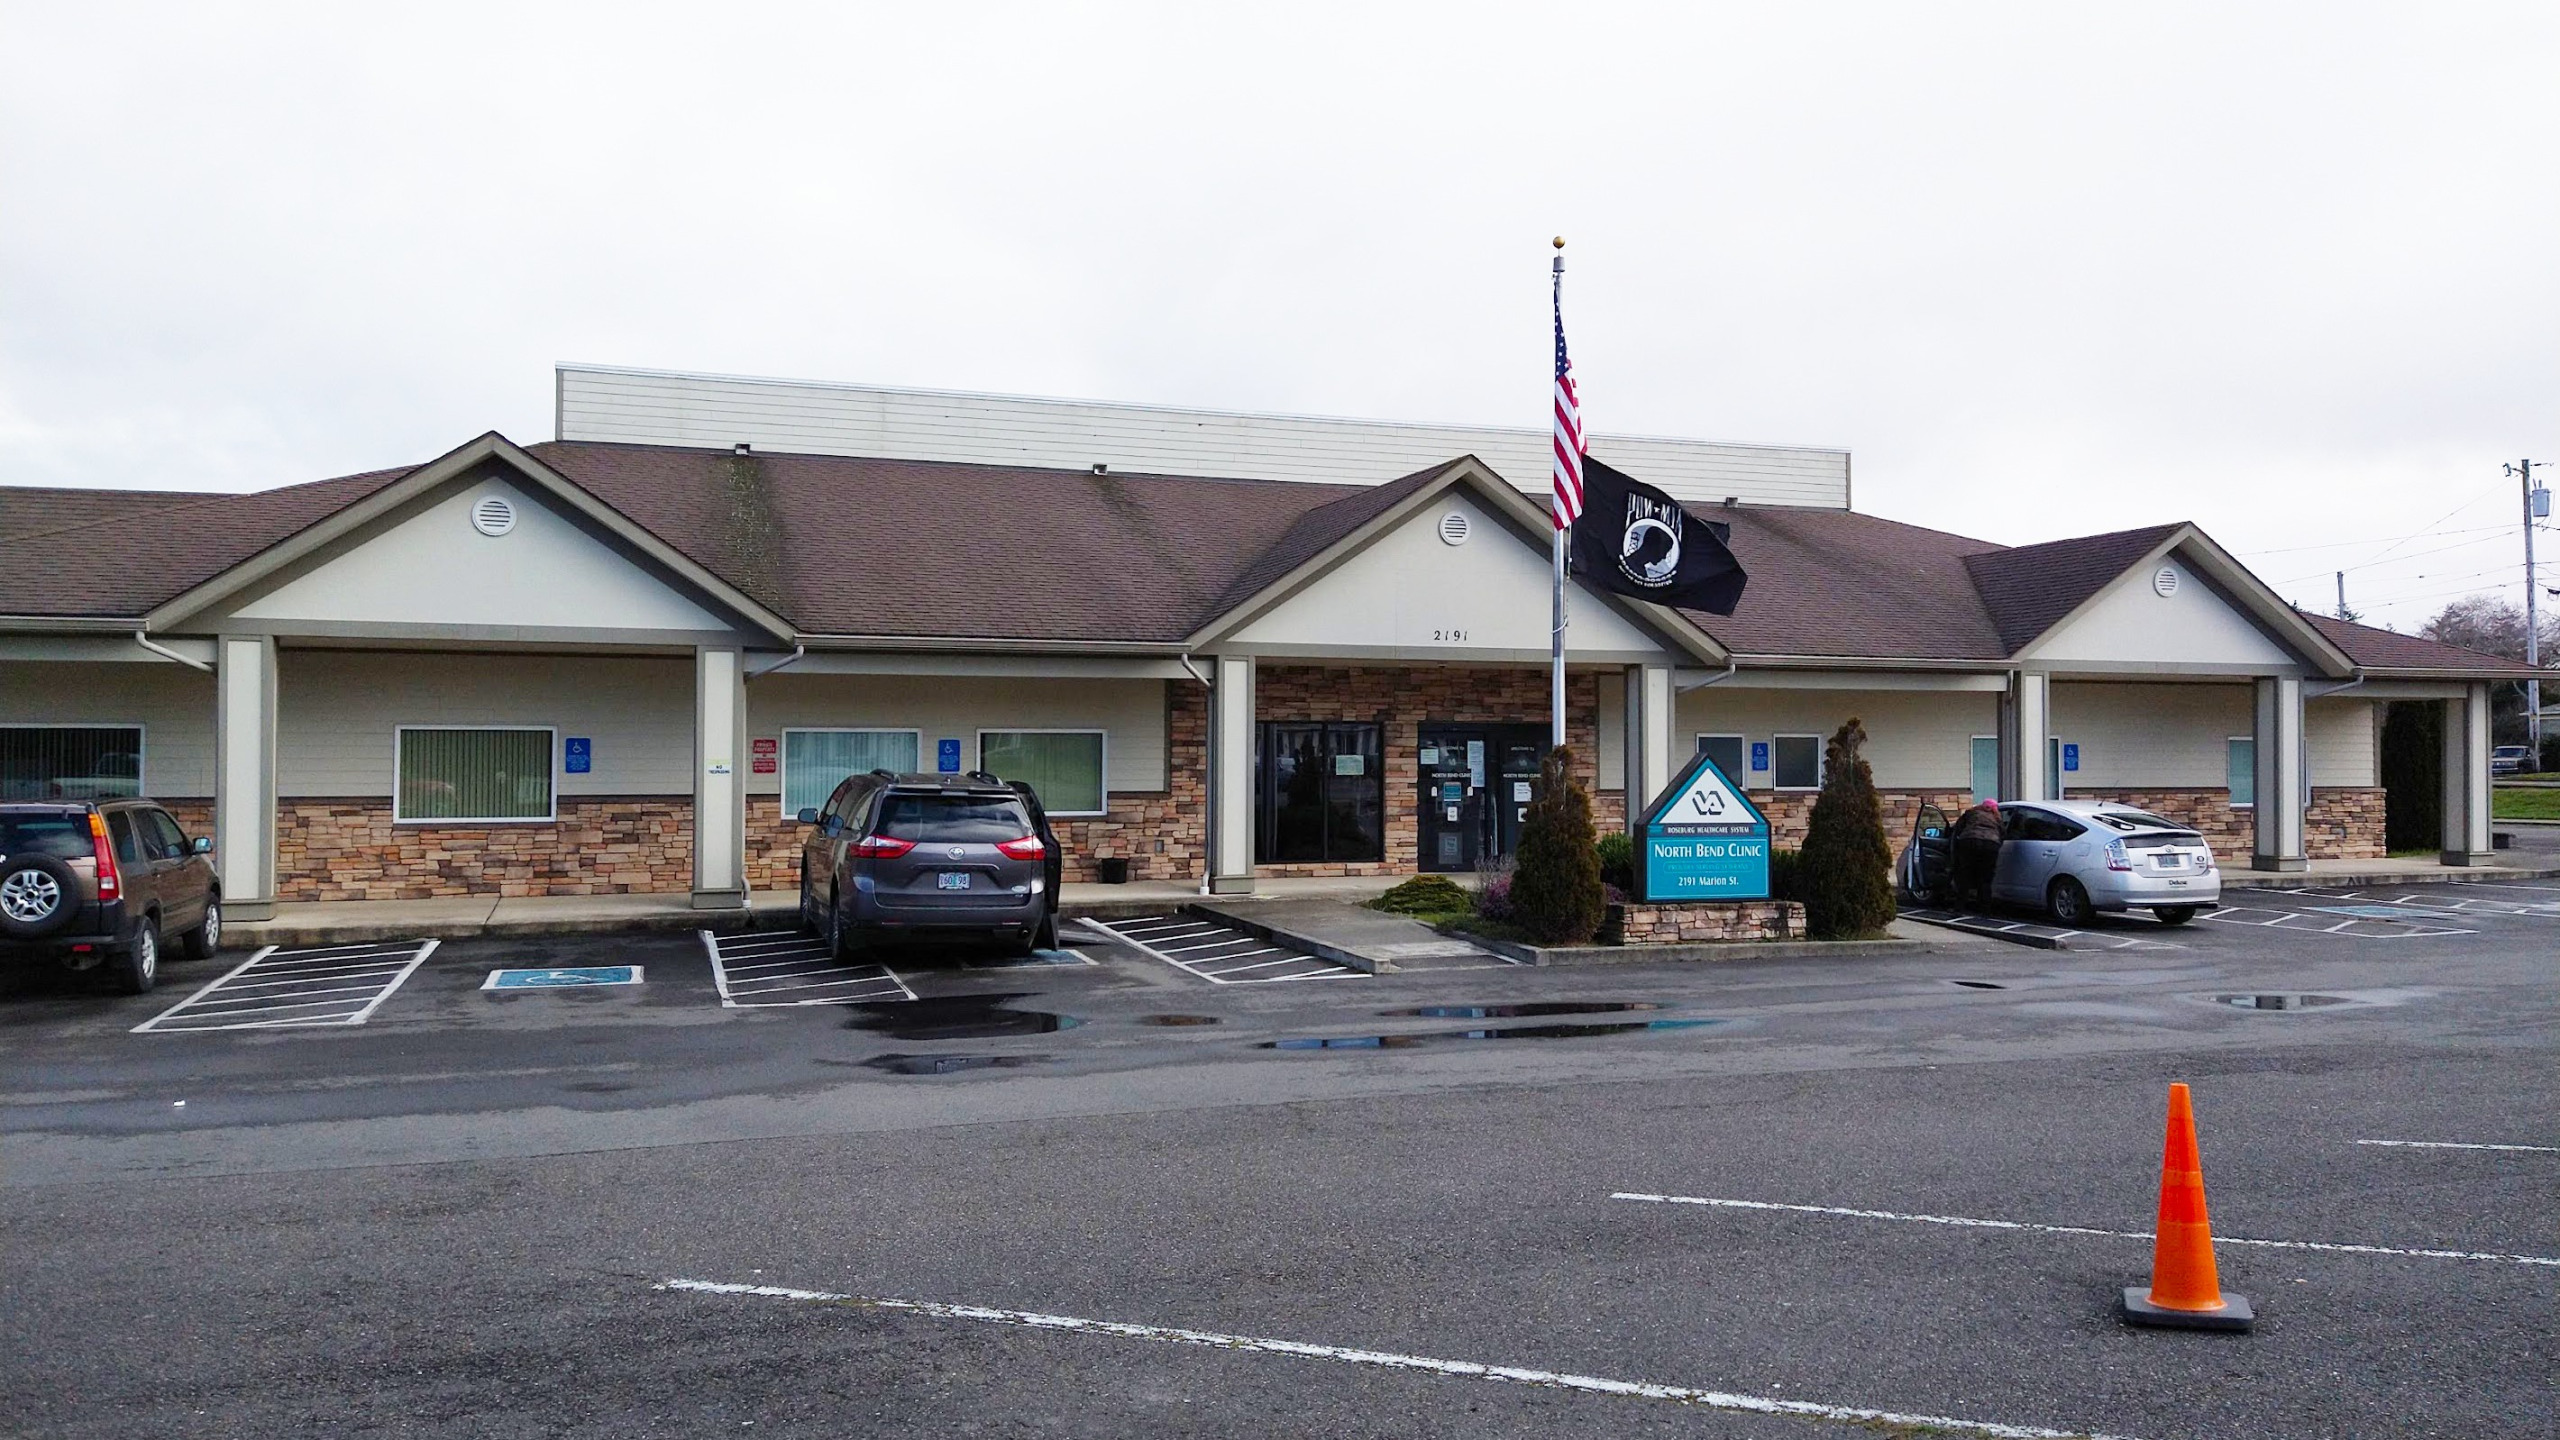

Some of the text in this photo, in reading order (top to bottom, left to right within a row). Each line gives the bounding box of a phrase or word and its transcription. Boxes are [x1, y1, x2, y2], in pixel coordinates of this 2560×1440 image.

[1625, 491, 1682, 542] POW MIA
[1433, 630, 1468, 641] 2191
[1667, 826, 1695, 834] ROSEBURG
[1678, 876, 1739, 887] 2191 Marion St.
